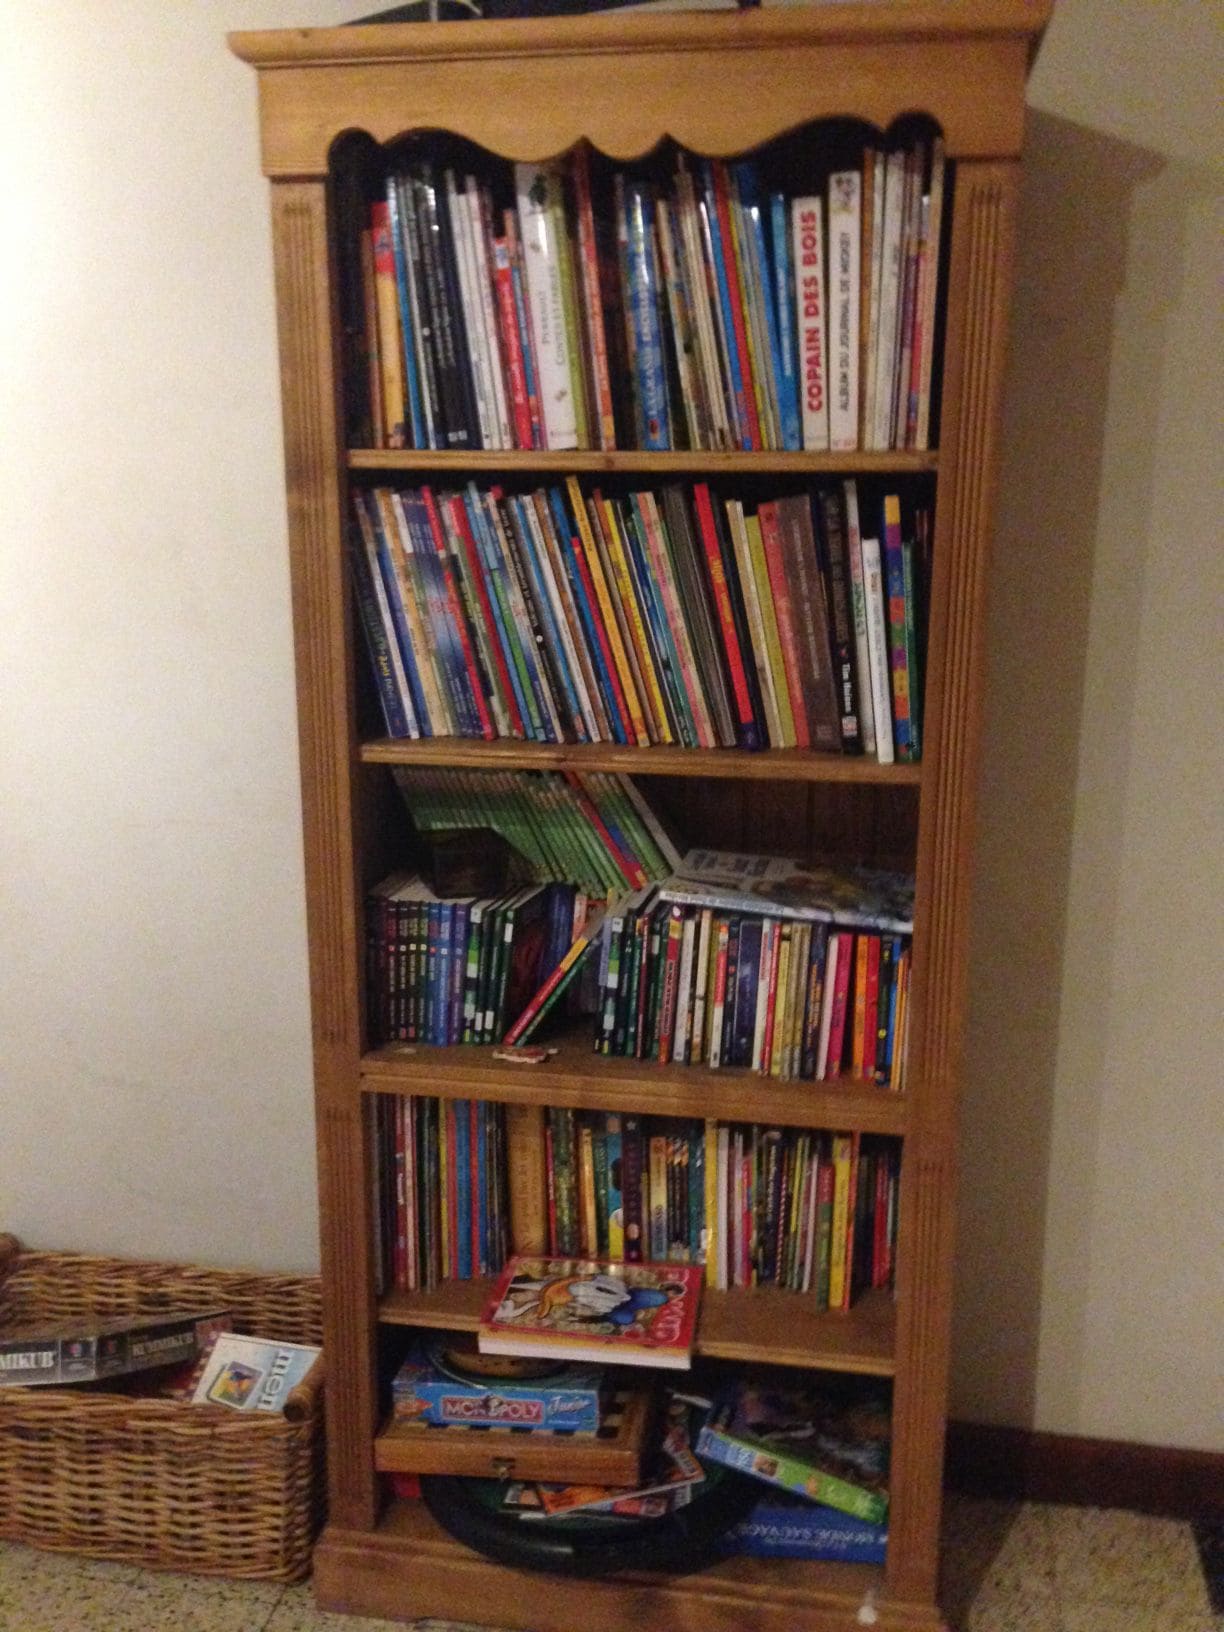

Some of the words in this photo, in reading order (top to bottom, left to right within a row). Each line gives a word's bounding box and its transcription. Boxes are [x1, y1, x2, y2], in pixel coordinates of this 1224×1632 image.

[801, 210, 817, 266] BOIS
[840, 232, 851, 275] MICKEY
[802, 276, 820, 317] DES
[840, 279, 850, 292] DE
[839, 298, 850, 349] JOURNAL
[804, 327, 823, 412] COPAIN
[839, 352, 849, 368] DU
[839, 373, 850, 411] ALBUM
[446, 1400, 541, 1421] MONPOLY
